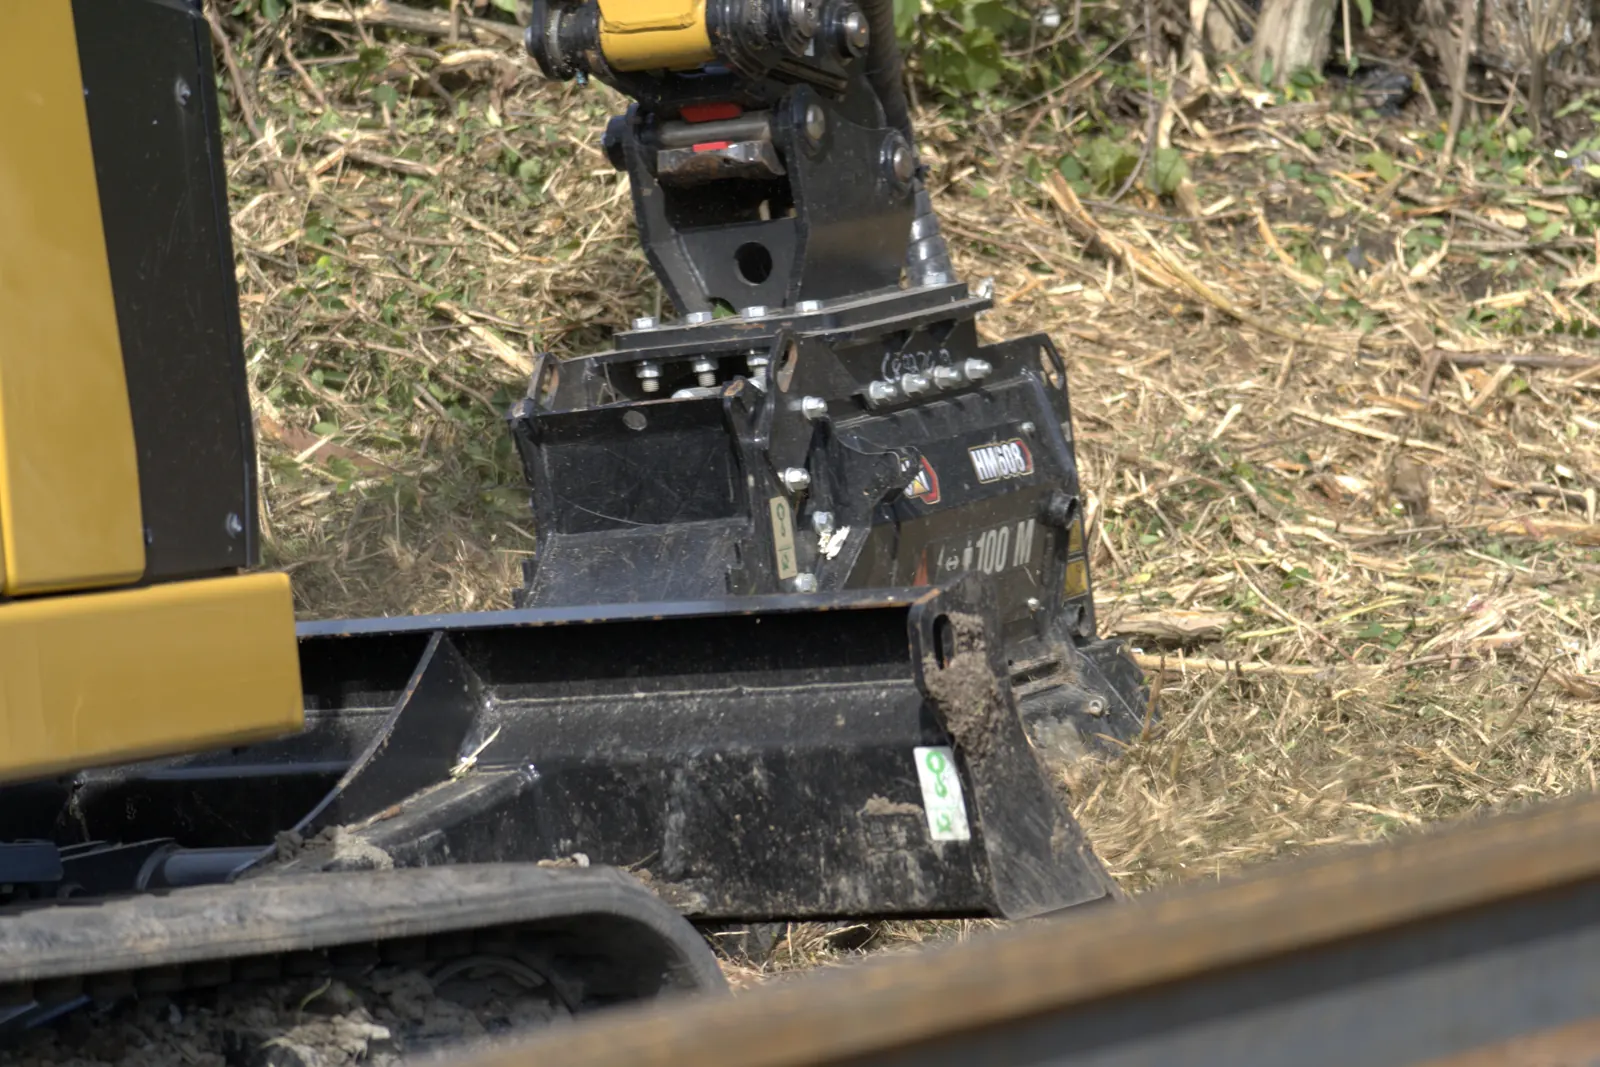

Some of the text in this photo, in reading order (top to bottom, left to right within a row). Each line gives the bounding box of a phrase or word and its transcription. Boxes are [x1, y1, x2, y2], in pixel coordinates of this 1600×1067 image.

[970, 442, 1026, 480] HM608
[976, 518, 1035, 575] 100 M
